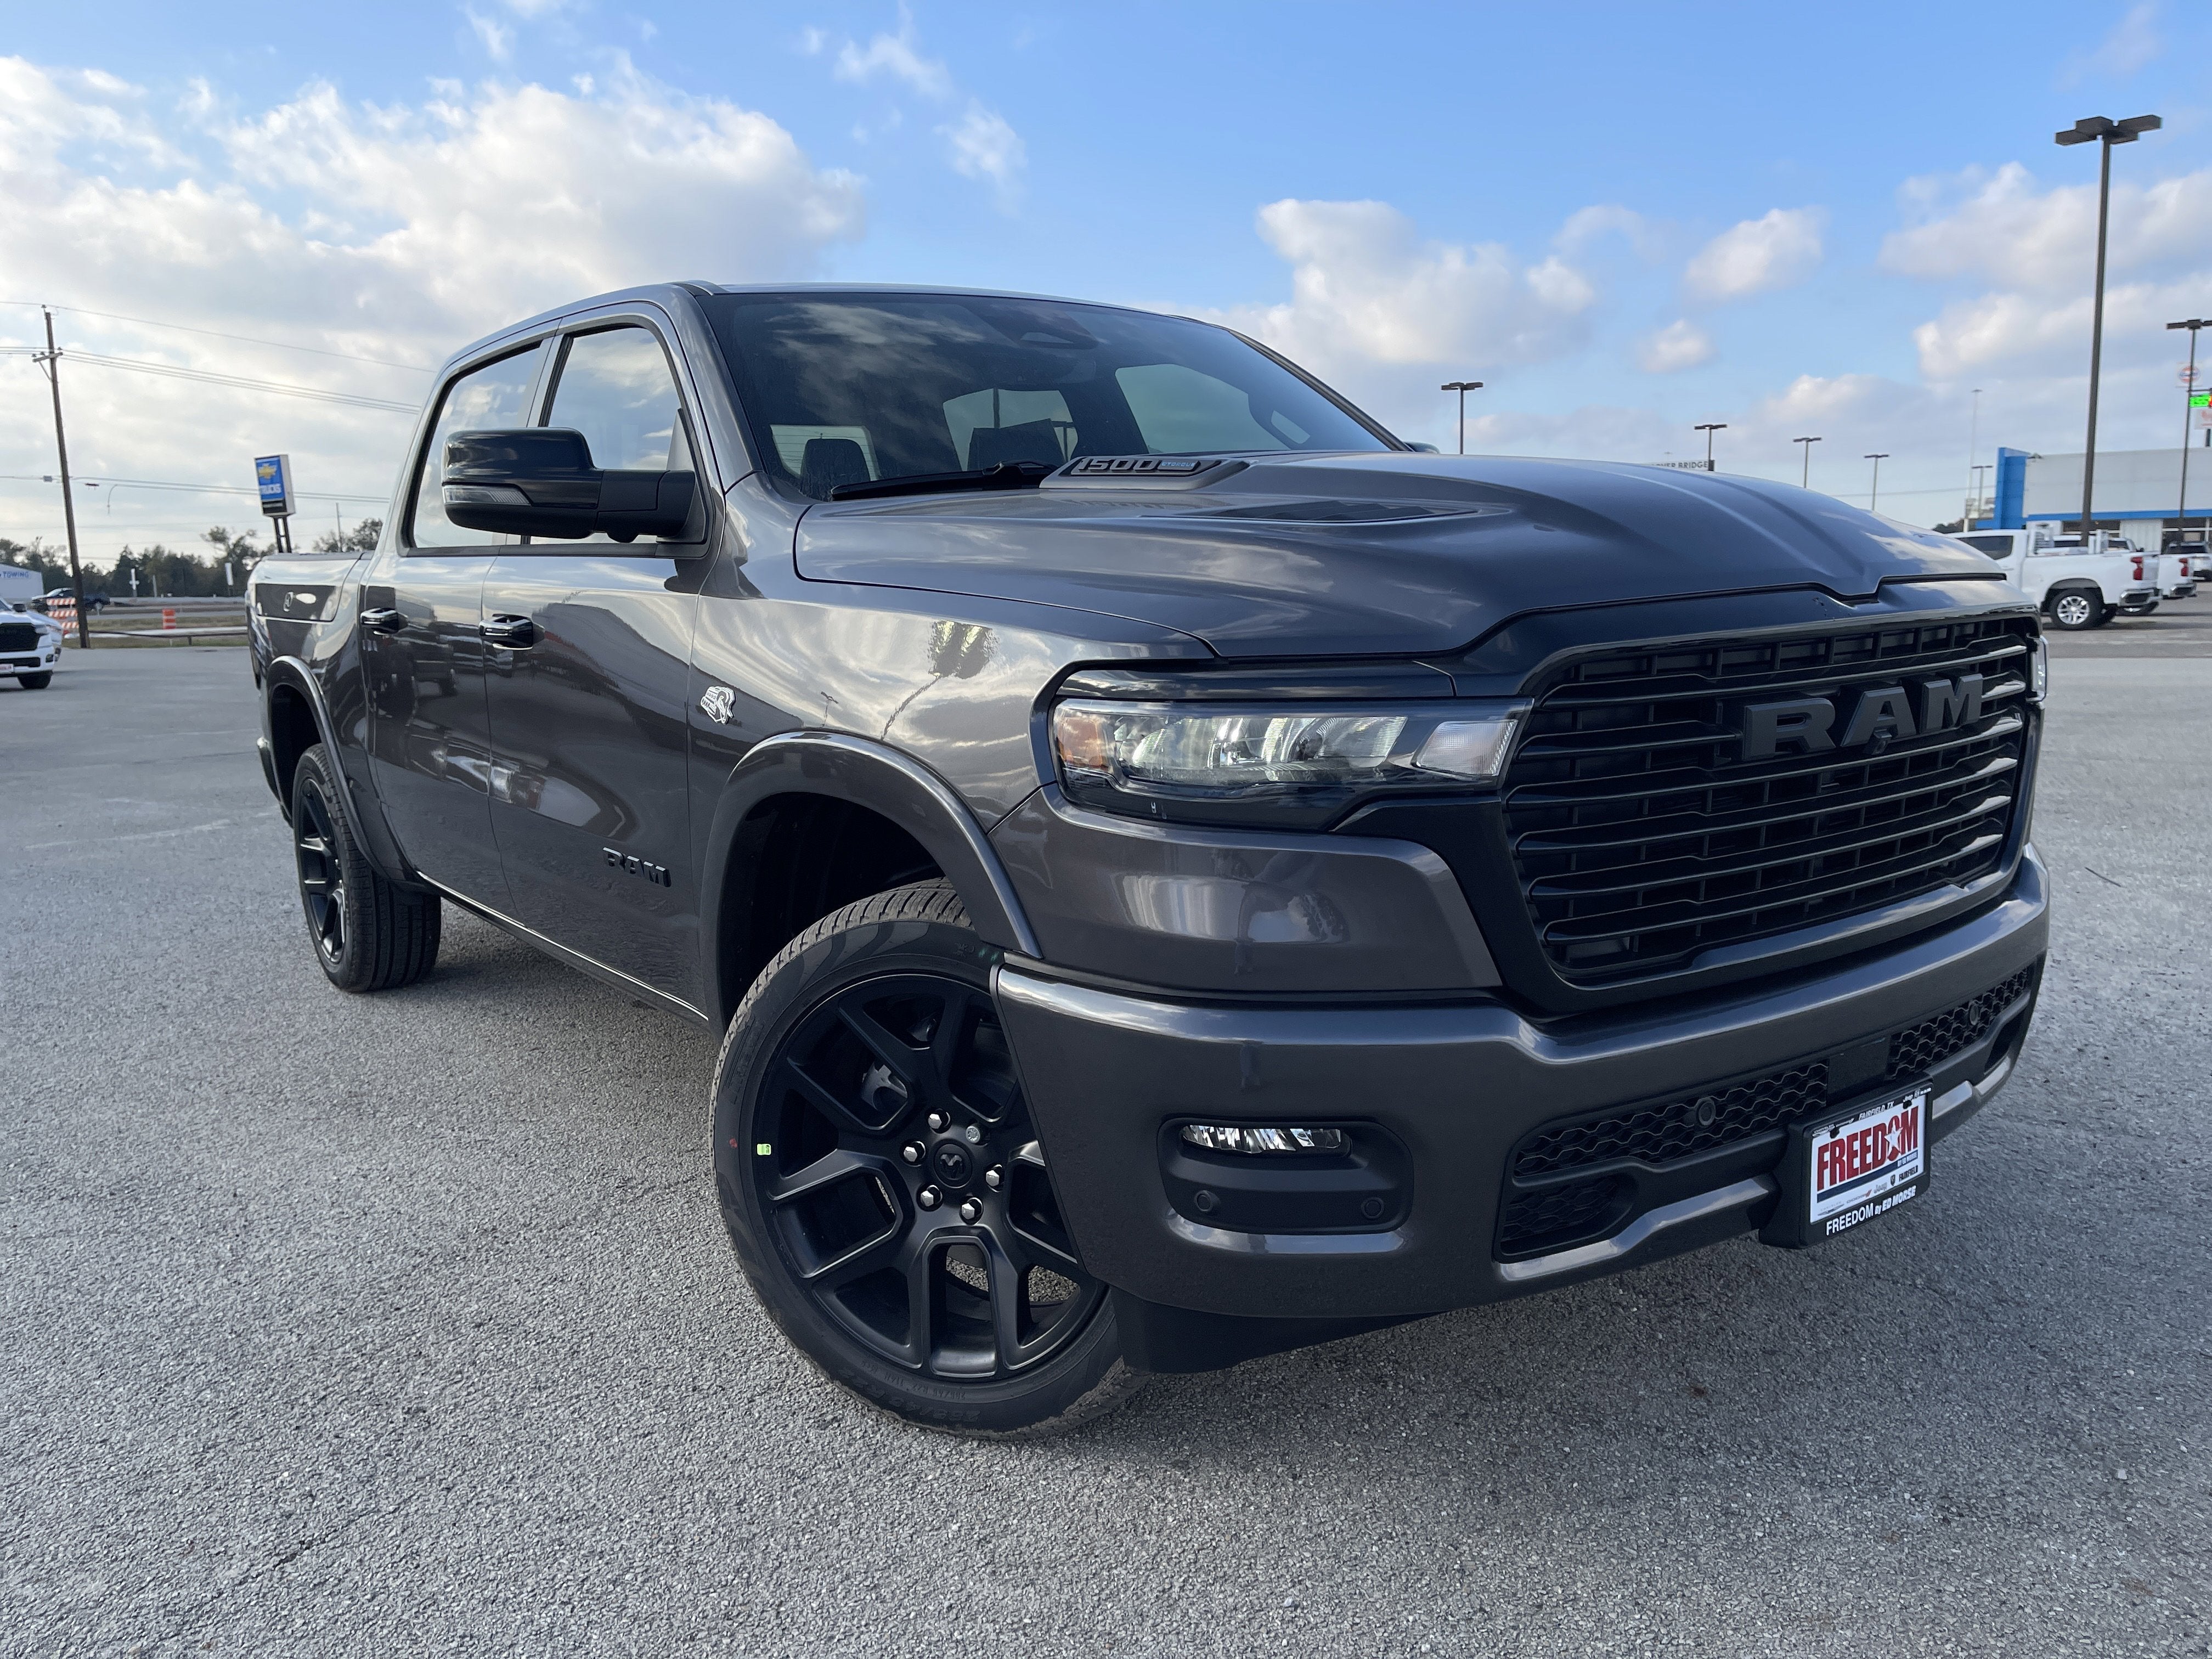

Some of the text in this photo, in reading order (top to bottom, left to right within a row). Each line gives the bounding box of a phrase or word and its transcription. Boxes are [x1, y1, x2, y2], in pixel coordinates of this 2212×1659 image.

[1078, 459, 1158, 472] 1500
[1742, 673, 1983, 760] RAM
[603, 847, 672, 888] RAM
[1817, 1105, 1918, 1192] FREEDOM
[1826, 1203, 1874, 1236] FREEDOM
[1882, 1198, 1892, 1212] ED
[1892, 1185, 1917, 1206] MORSE
